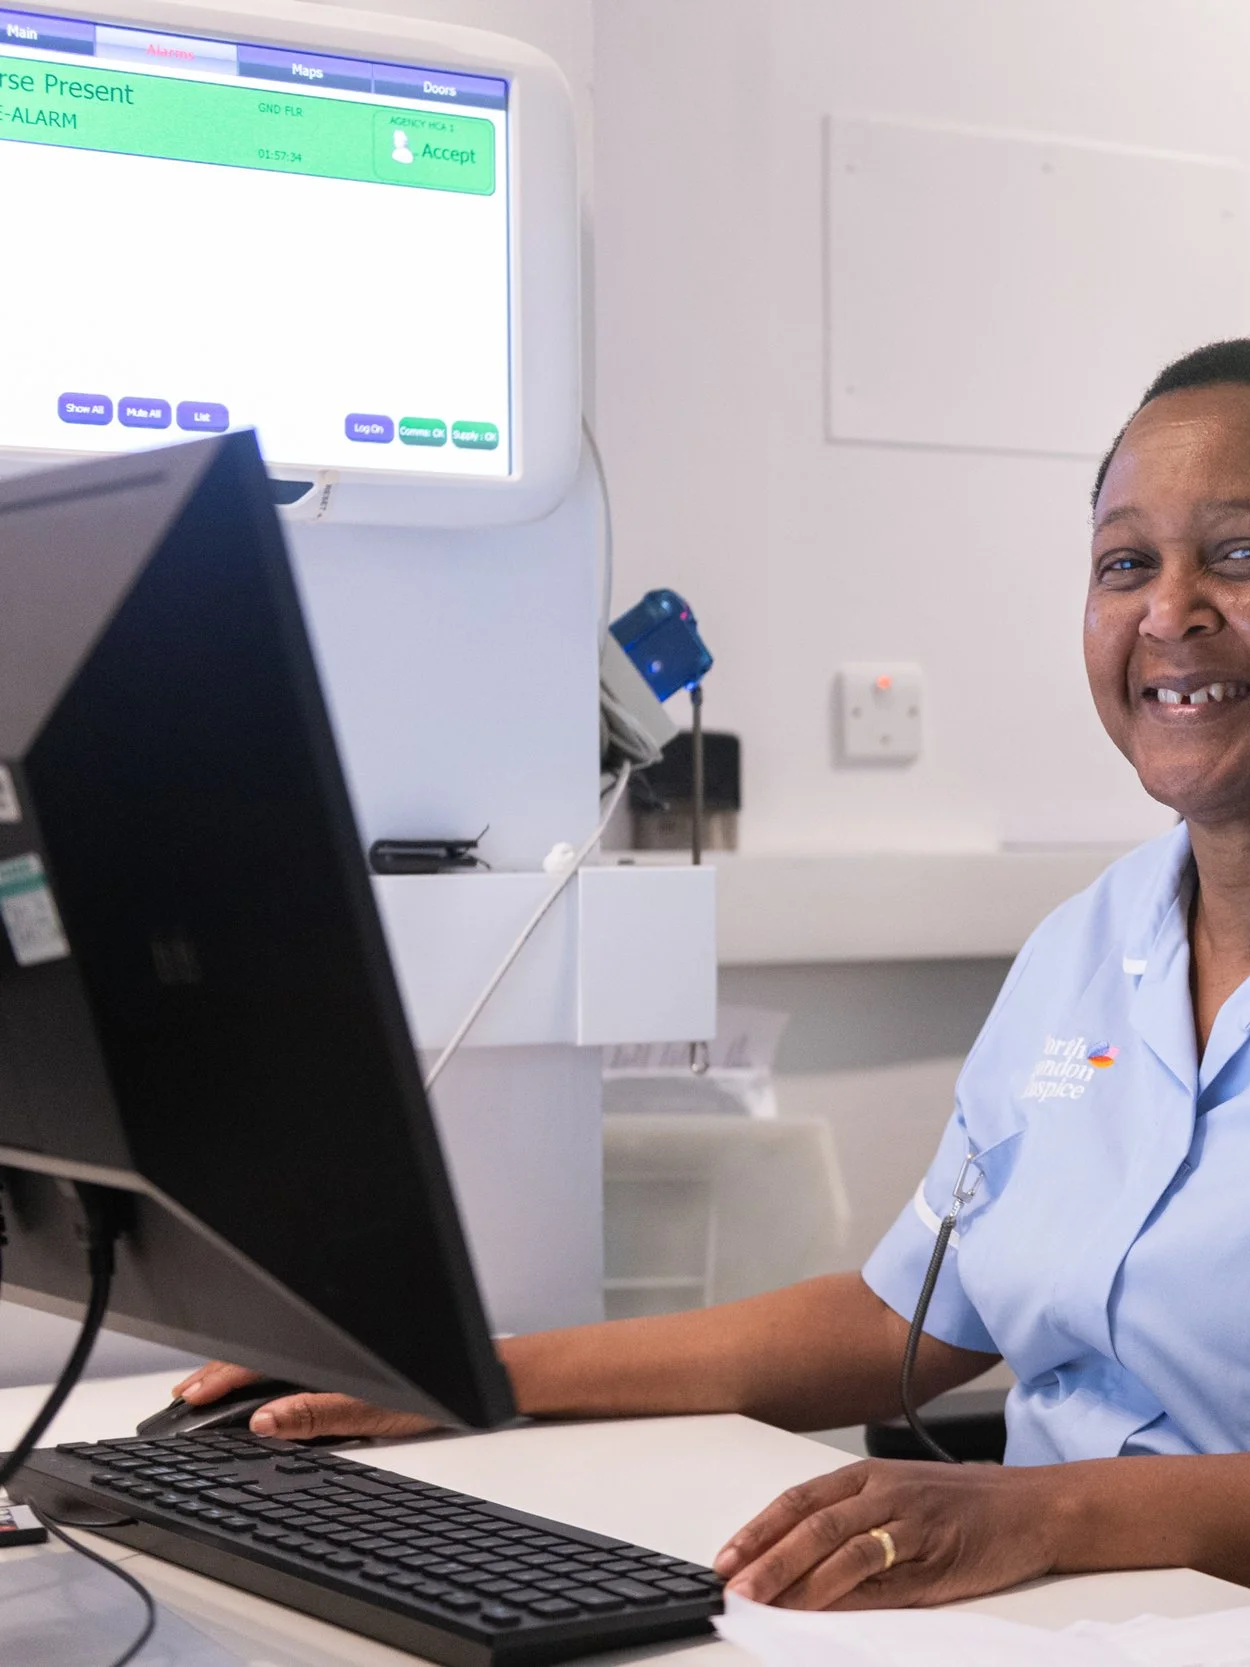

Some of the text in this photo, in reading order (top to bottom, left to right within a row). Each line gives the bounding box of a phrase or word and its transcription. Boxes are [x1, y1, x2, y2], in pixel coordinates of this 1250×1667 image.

[7, 23, 38, 40] Main
[146, 43, 195, 61] Alarms
[291, 63, 324, 80] Maps
[0, 73, 134, 105] rse Present
[423, 81, 457, 97] Doors
[258, 102, 303, 117] GND FLR
[389, 115, 426, 129] AGENCY
[257, 148, 303, 163] 01:57:34
[421, 142, 477, 166] Accept
[65, 403, 105, 415] Show All
[126, 407, 162, 419] Mute All
[193, 412, 211, 422] List
[353, 422, 385, 435] Log On
[432, 427, 446, 439] OK
[452, 429, 479, 442] Supply
[484, 430, 497, 442] OK
[1043, 1033, 1087, 1060] orth
[1034, 1055, 1096, 1082] ondon
